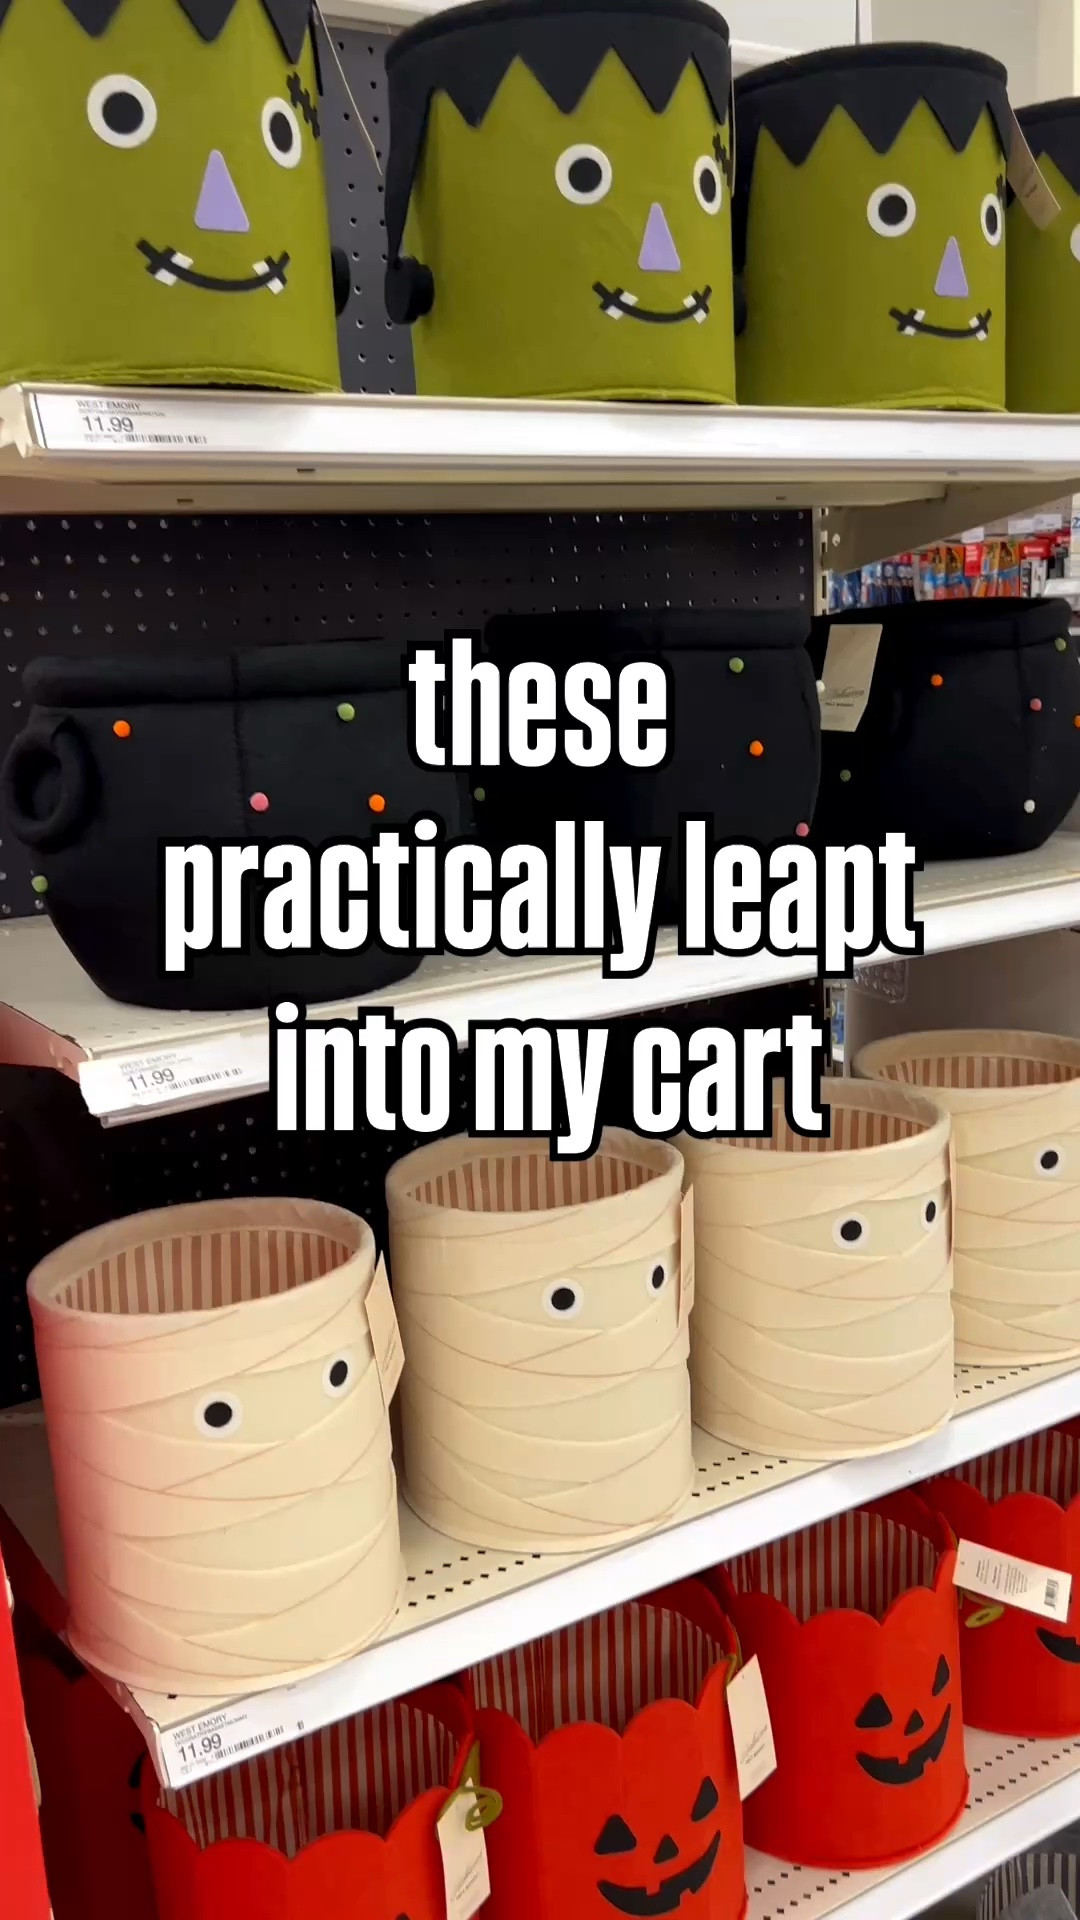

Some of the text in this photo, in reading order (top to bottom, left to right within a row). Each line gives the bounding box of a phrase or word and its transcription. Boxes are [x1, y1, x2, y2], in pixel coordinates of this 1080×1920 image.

[105, 400, 141, 411] EMORY
[82, 415, 134, 433] 11.99
[127, 1067, 175, 1091] 11.99
[172, 1724, 197, 1740] WEST
[197, 1713, 228, 1729] EMORY
[179, 1732, 222, 1762] 11.99
